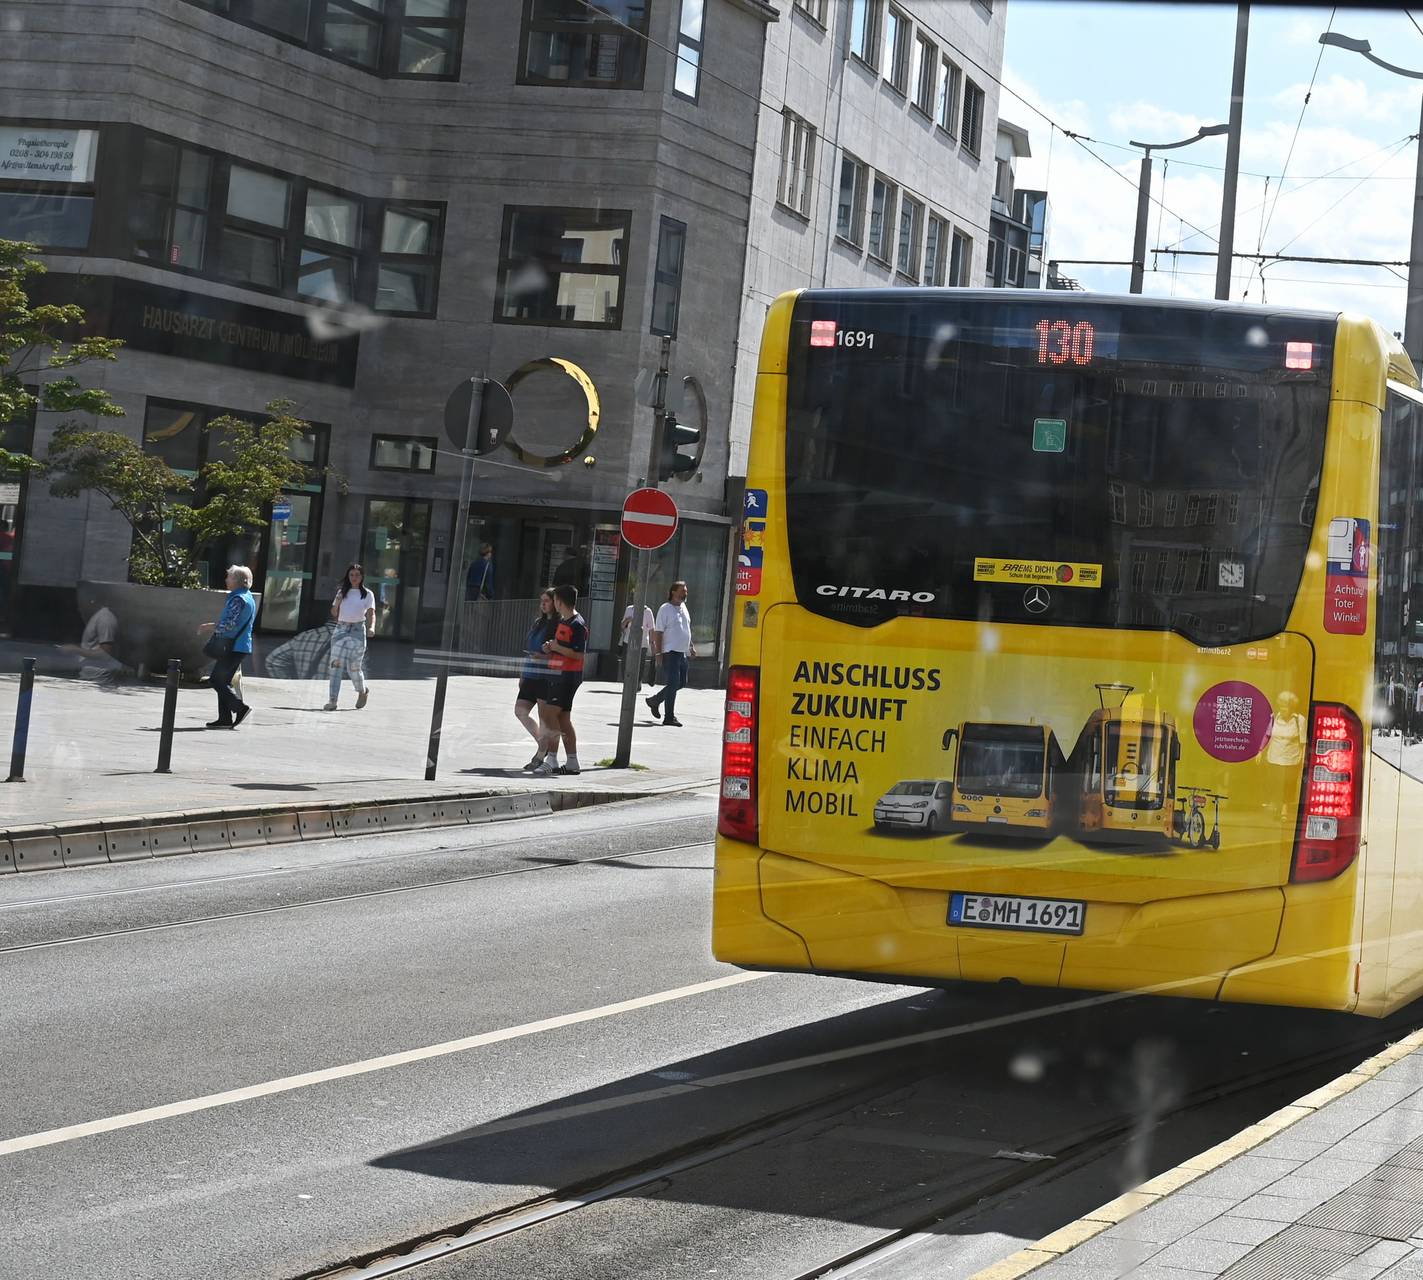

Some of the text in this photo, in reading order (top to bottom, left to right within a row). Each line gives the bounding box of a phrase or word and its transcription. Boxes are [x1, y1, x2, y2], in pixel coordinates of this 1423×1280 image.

[17, 138, 70, 150] Physiotherapie
[143, 304, 216, 341] HAUSARZT
[217, 319, 281, 354] CENTRUM
[835, 330, 875, 350] 1691
[1035, 319, 1095, 366] 130
[1001, 563, 1034, 574] BREMS
[816, 584, 936, 603] CITARO
[1334, 584, 1366, 598] Achtung!
[1334, 598, 1355, 609] Toter
[792, 660, 941, 691] ANSCHLUSS
[791, 692, 908, 722] ZUKUNFT
[789, 725, 886, 753] EINFACH
[787, 757, 859, 785] KLIMA
[785, 789, 859, 817] MOBIL
[963, 898, 978, 921] E
[992, 900, 1022, 924] MH
[1025, 902, 1080, 928] 1691
